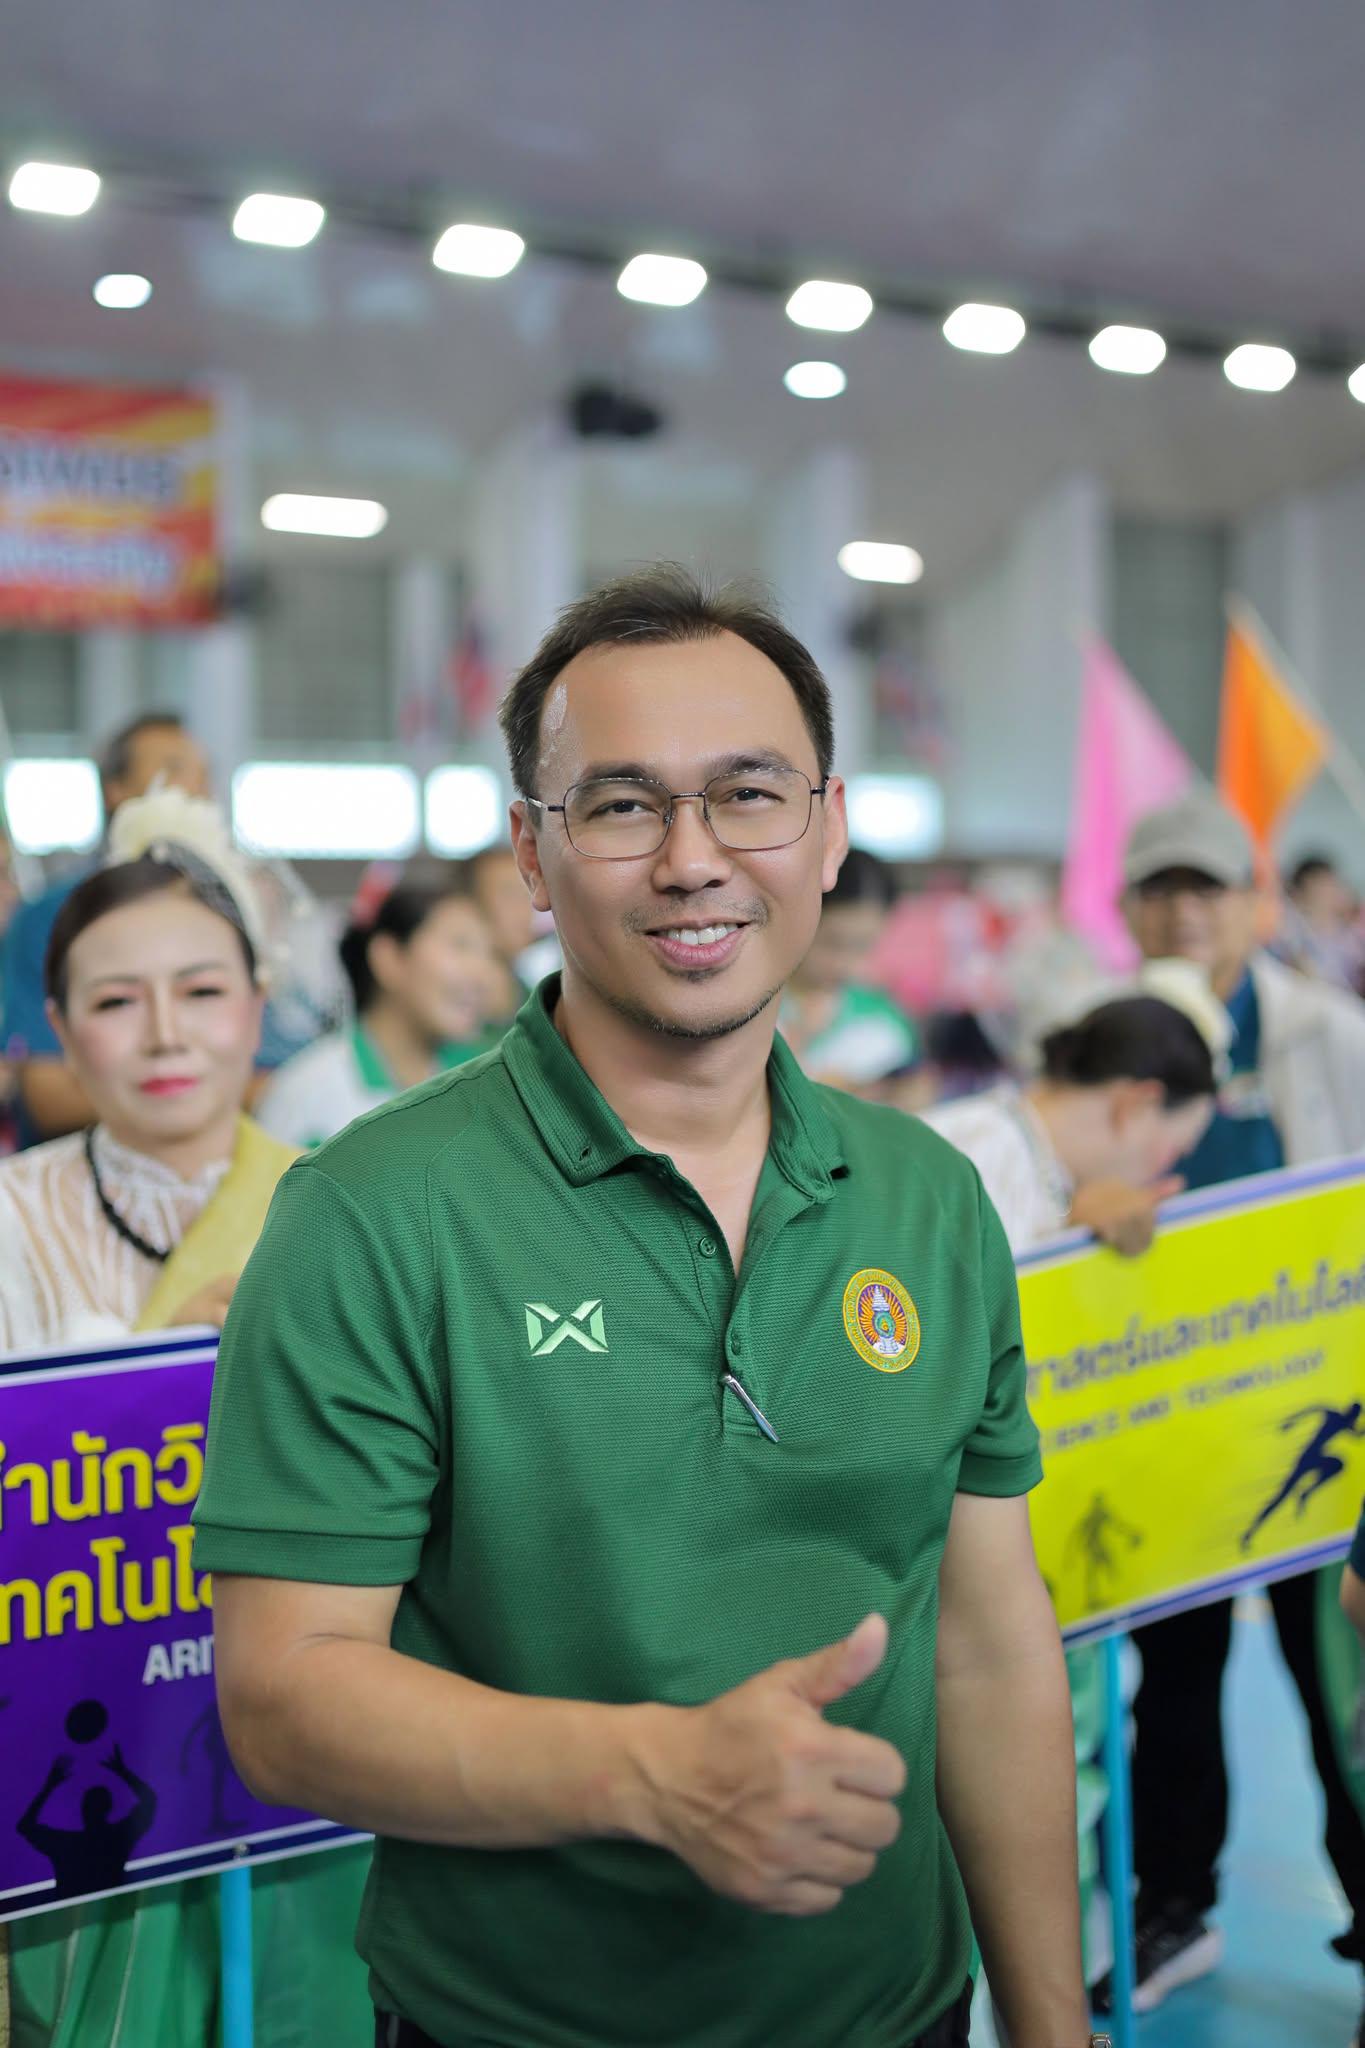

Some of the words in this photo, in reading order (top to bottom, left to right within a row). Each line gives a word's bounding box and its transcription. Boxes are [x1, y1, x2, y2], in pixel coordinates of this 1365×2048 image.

[0, 1422, 204, 1532] ำนักวิ
[142, 1634, 214, 1686] ARI
